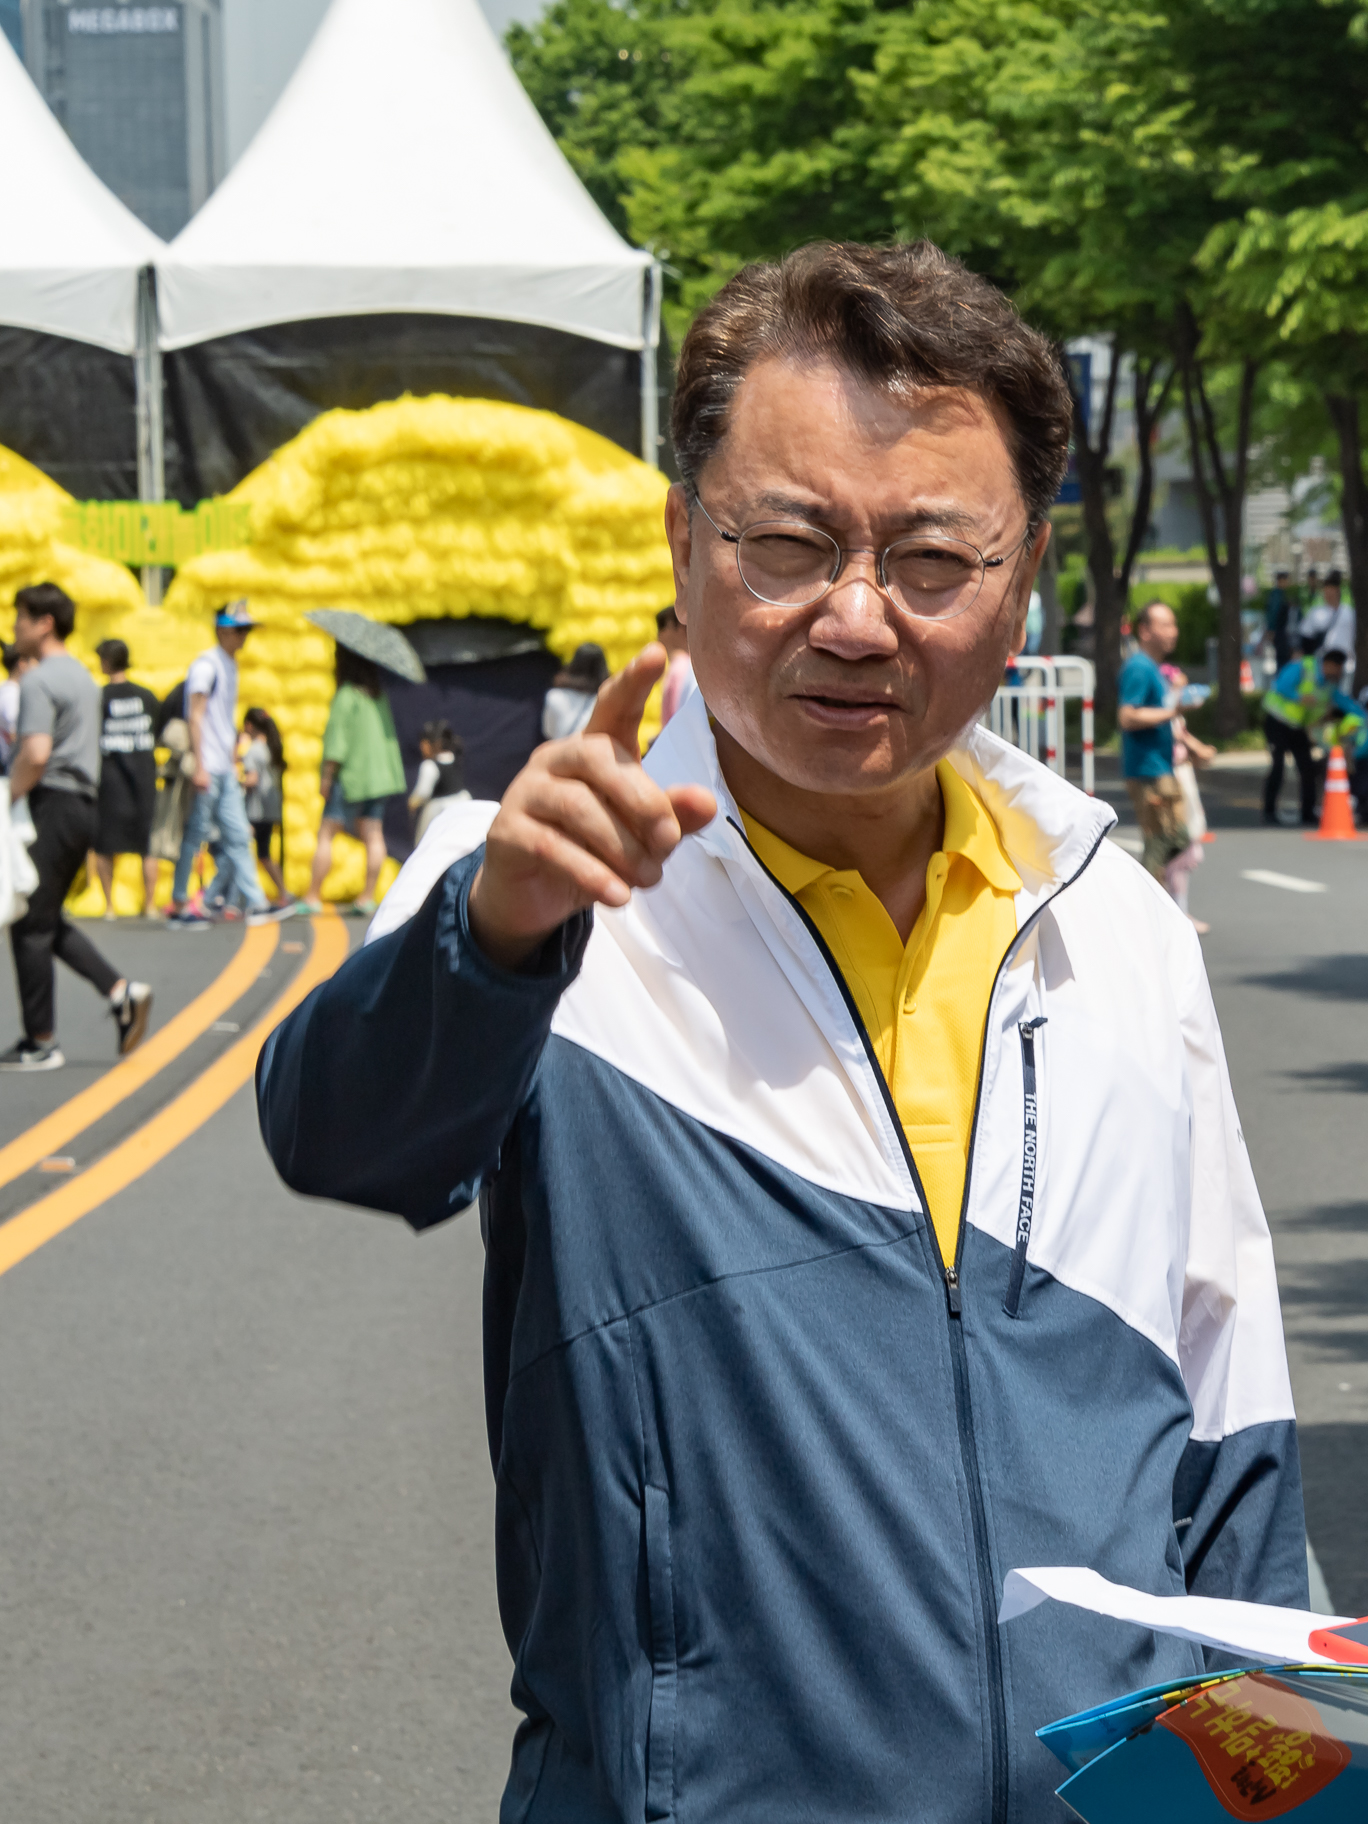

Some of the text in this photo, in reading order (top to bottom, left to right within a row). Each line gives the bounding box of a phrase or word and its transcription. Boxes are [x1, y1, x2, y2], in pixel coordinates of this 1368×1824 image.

[67, 7, 179, 33] MEGABOX
[1017, 1092, 1037, 1244] THE NORTH FACE
